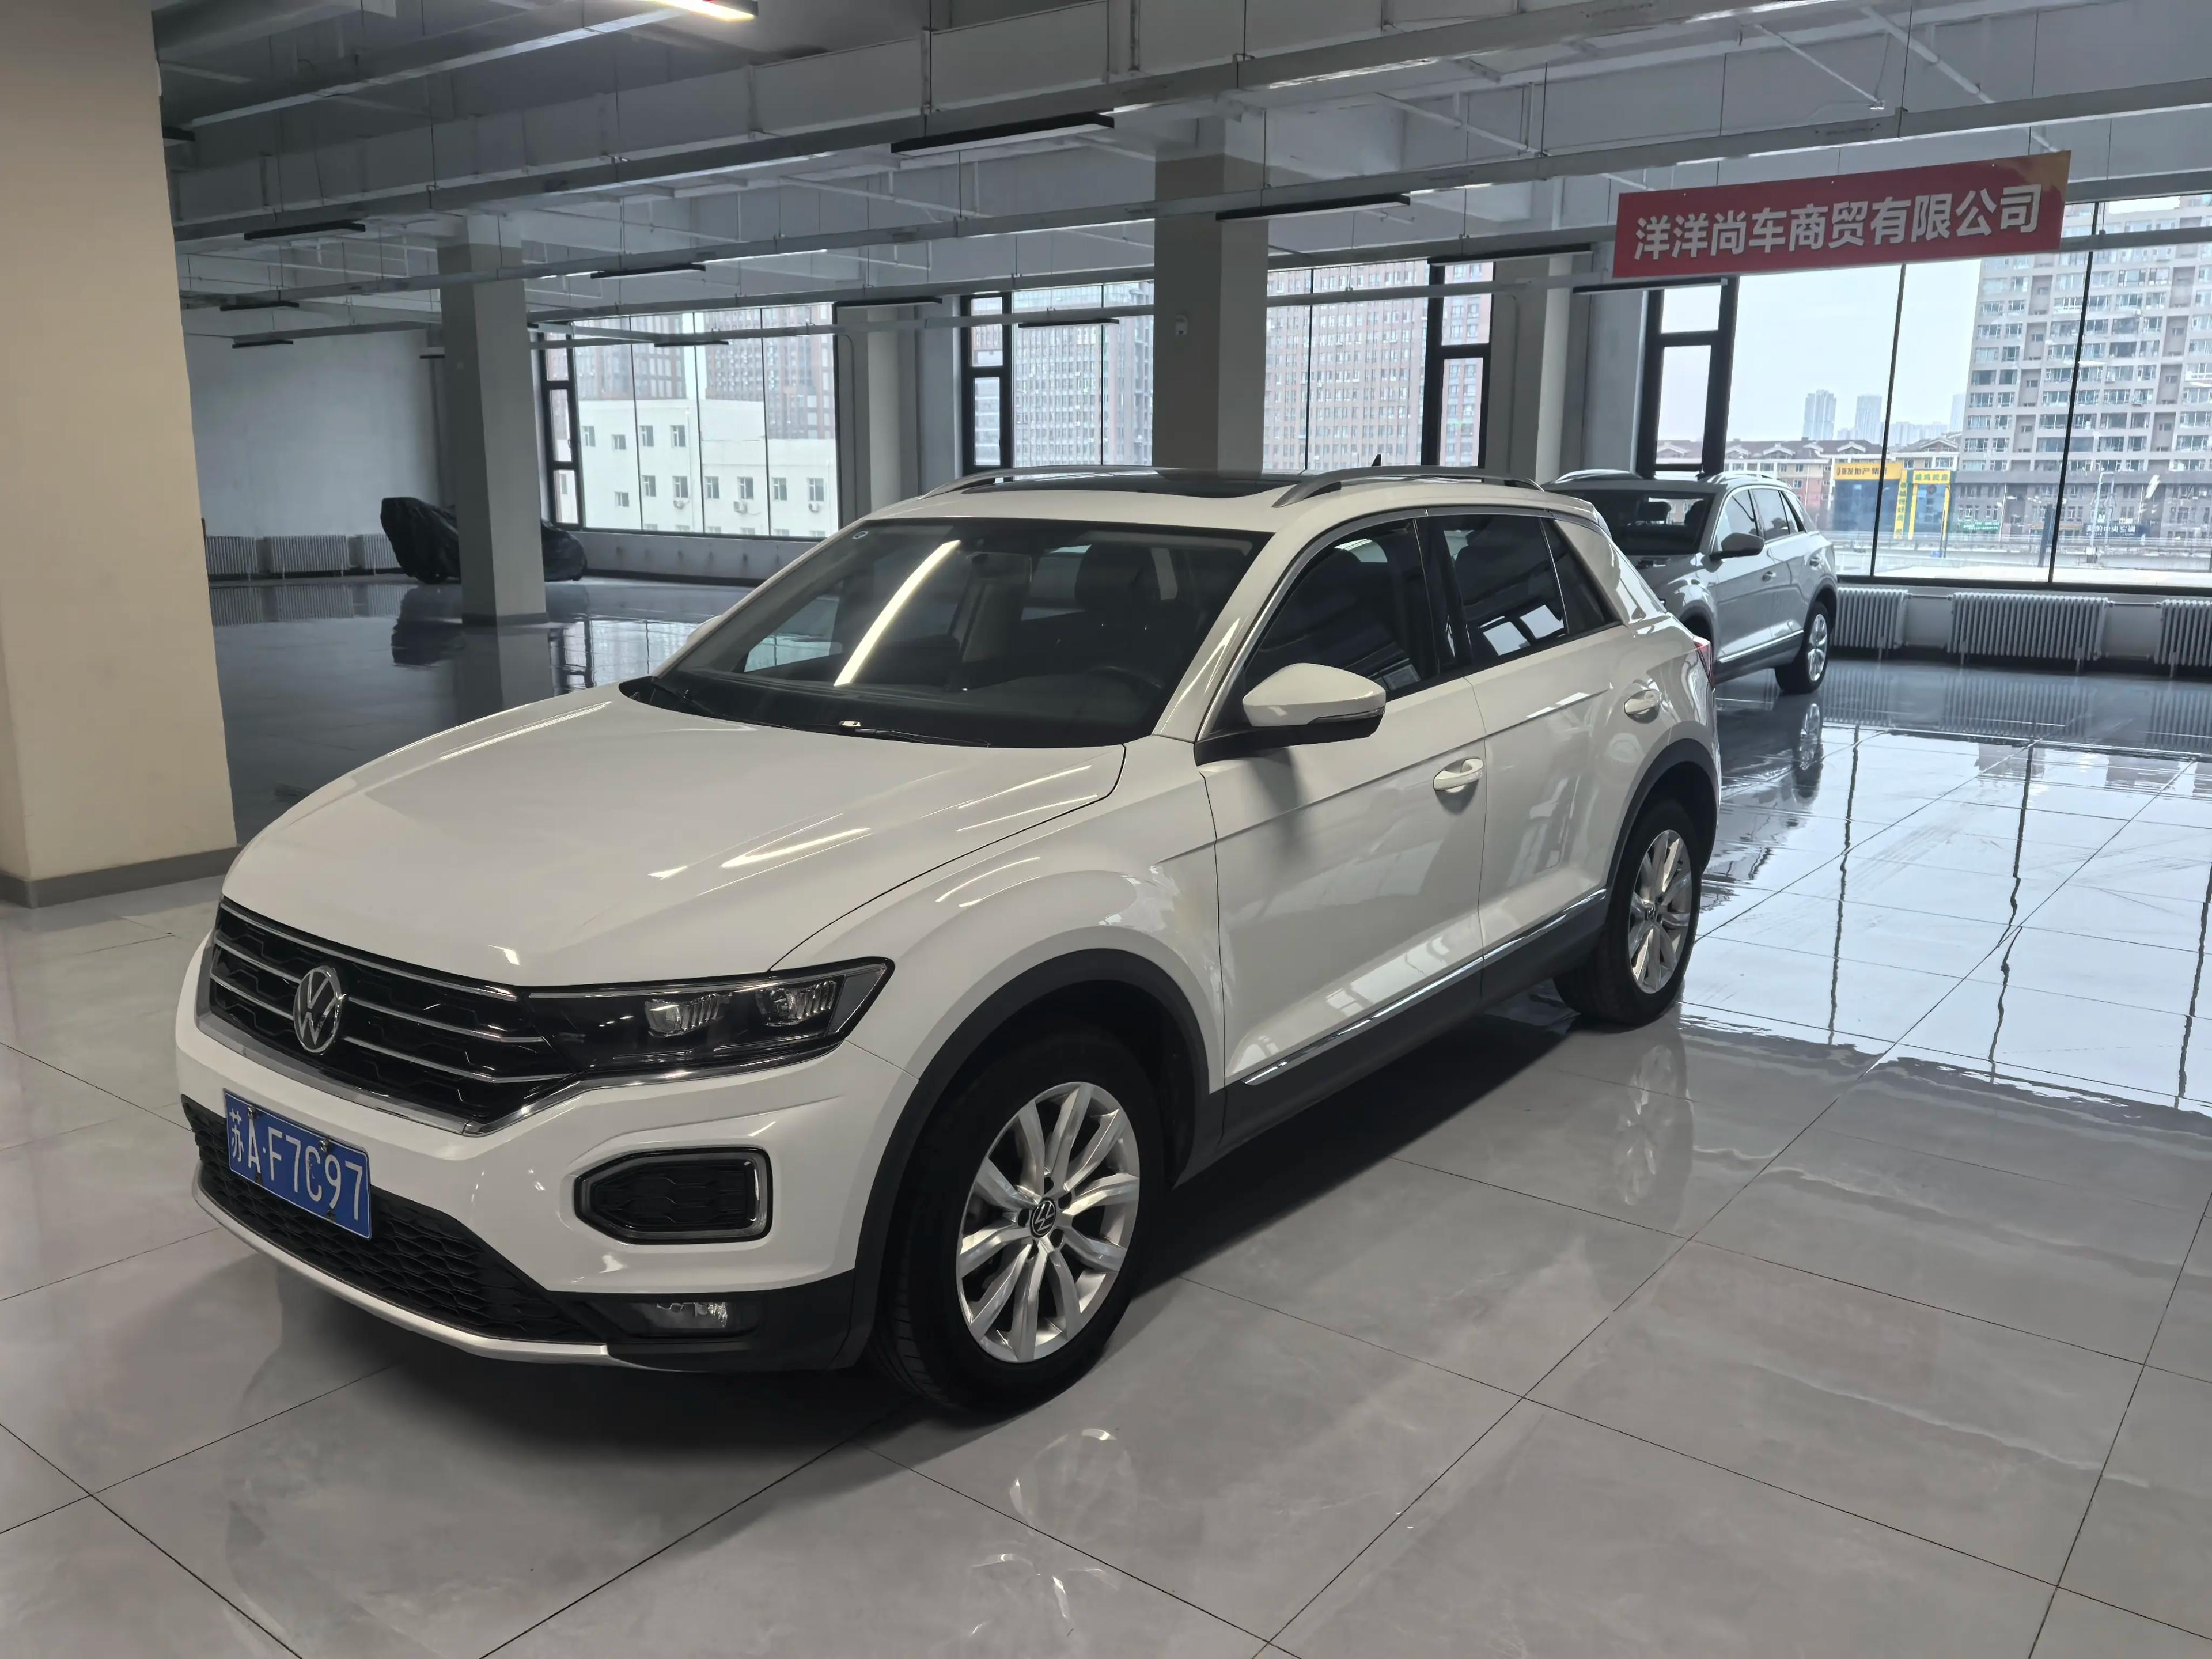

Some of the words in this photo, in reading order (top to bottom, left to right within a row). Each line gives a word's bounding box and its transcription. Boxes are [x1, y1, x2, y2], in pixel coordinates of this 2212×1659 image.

[1634, 184, 2042, 261] 洋洋尚车商贸有限公司
